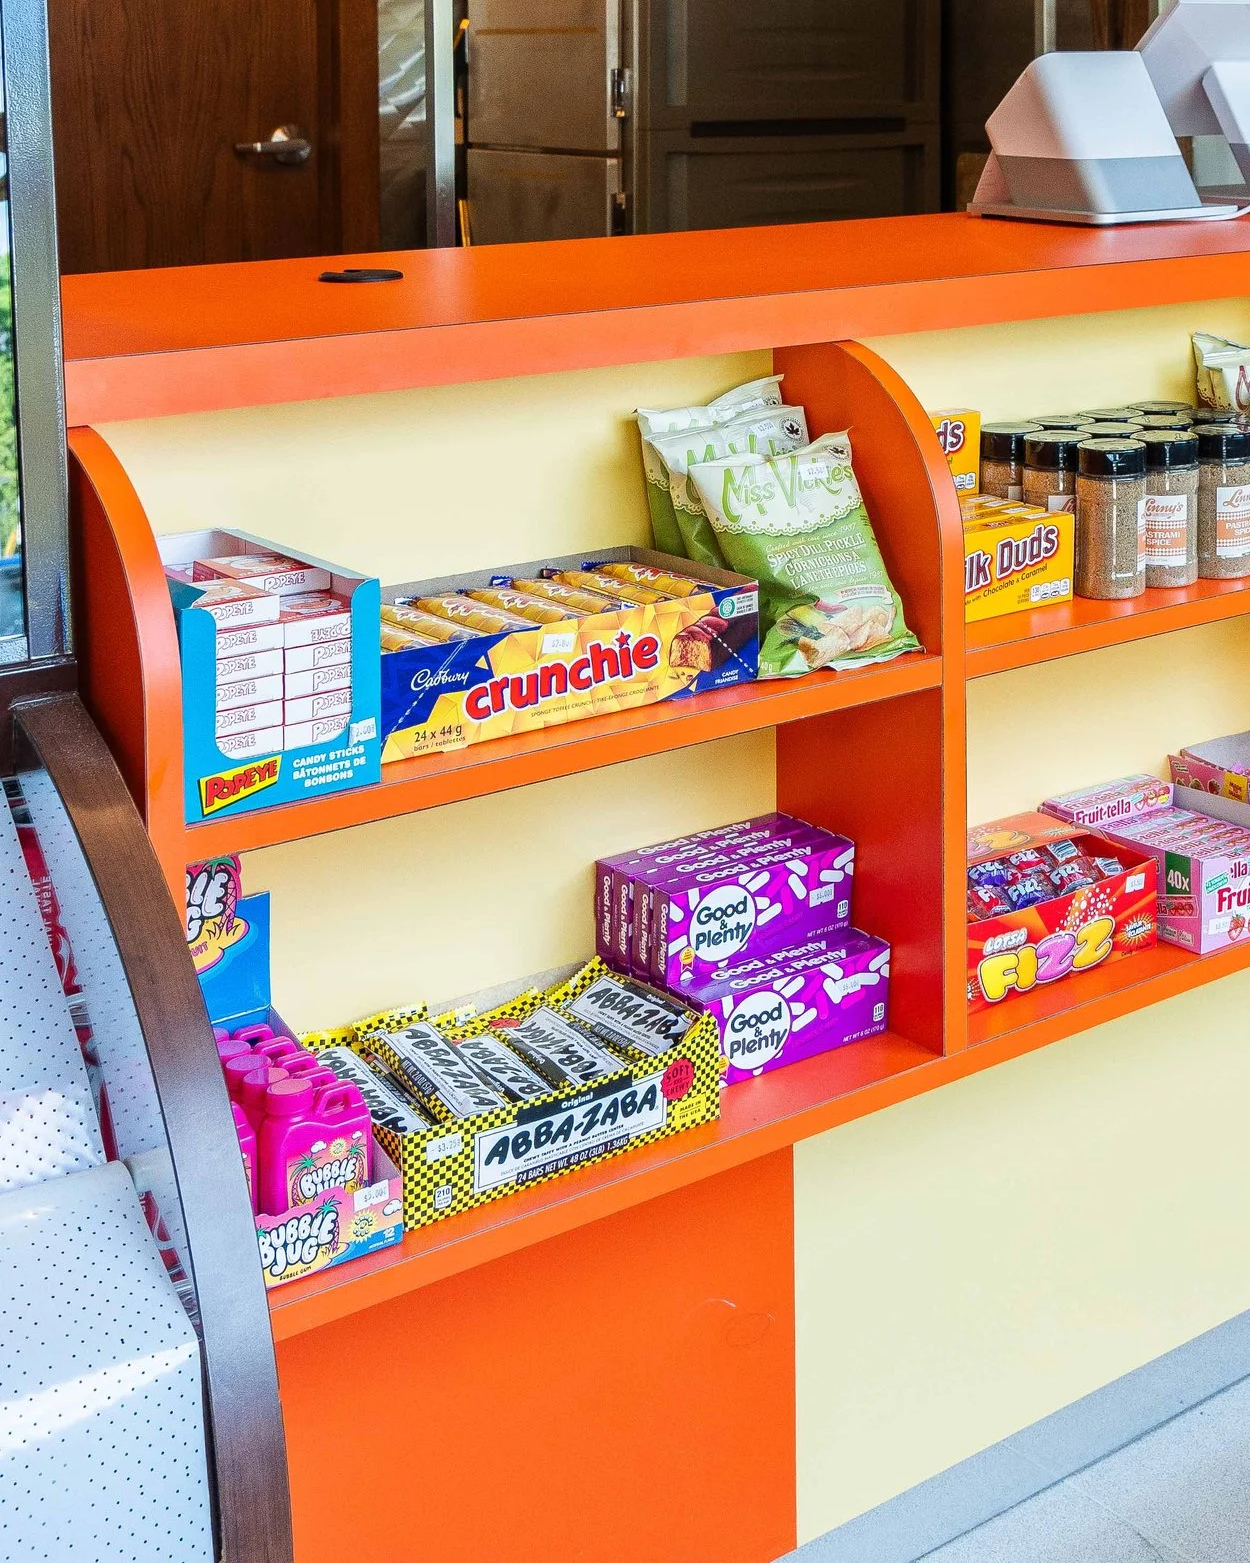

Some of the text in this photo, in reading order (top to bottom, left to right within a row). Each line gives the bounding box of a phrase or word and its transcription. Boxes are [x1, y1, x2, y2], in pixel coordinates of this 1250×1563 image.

[721, 465, 776, 524] Miss
[1142, 498, 1184, 519] Linny's
[766, 532, 866, 568] SPICY DILL PICKLE
[997, 526, 1056, 576] Duds
[1146, 538, 1172, 546] SPICE
[784, 550, 853, 577] CORNICHONS
[264, 572, 306, 592] POPEYE
[982, 563, 1048, 597] Chocolate Caramel
[210, 601, 254, 621] POPEYE
[216, 631, 258, 656] POPEYE
[410, 668, 470, 692] Cadbury
[465, 631, 660, 721] crunchie
[714, 674, 739, 685] FRIANDISE
[721, 669, 739, 678] CANDY
[530, 708, 552, 718] SPONGE
[552, 705, 570, 714] TOFFEE
[570, 699, 593, 710] CRUNCH
[629, 685, 660, 697] CROQUANTE
[413, 736, 466, 753] bars tablettes
[414, 724, 463, 744] 24 x 44 g
[292, 744, 365, 769] CANDY STICKS
[292, 756, 367, 780] BÂTONNETS DE
[204, 759, 278, 809] POPEYE
[304, 770, 354, 788] BONBONS
[1073, 797, 1131, 825] Fruit-tella
[695, 846, 812, 882] Good Plenty
[1007, 879, 1042, 902] FIZZ
[1166, 869, 1191, 892] 40x
[695, 895, 748, 927] Good
[838, 901, 849, 911] 110
[695, 921, 753, 952] Plenty
[719, 919, 728, 930] &
[985, 928, 1028, 954] LOTSA
[658, 941, 668, 975] Plenty
[711, 941, 827, 980] Good Plenty
[729, 948, 847, 989] Good Plenty
[977, 915, 1115, 1003] FIZZ
[730, 1001, 783, 1034] Good
[729, 1028, 788, 1060] Plenty
[754, 1026, 763, 1038] &
[405, 1027, 499, 1107] ABBA-ZABA
[665, 1063, 691, 1082] SOFT
[561, 1091, 595, 1109] Original
[665, 1083, 691, 1098] CHEWY
[678, 1113, 689, 1121] THE
[679, 1099, 702, 1112] MADE IN
[484, 1083, 658, 1168] ABBA-ZABA
[523, 1123, 625, 1164] CHEWY TAFFY WITH PEANUT BUTTER CENTER
[517, 1137, 629, 1184] 24 BARS NET WT. 48 OZ (3LB) 1.36KG
[299, 1156, 359, 1200] BUBBLE
[436, 1187, 451, 1199] 210
[257, 1212, 339, 1269] BUBBLE
[383, 1228, 395, 1238] 12
[269, 1236, 320, 1277] JUG
[278, 1265, 312, 1281] BUBBLE GUM
